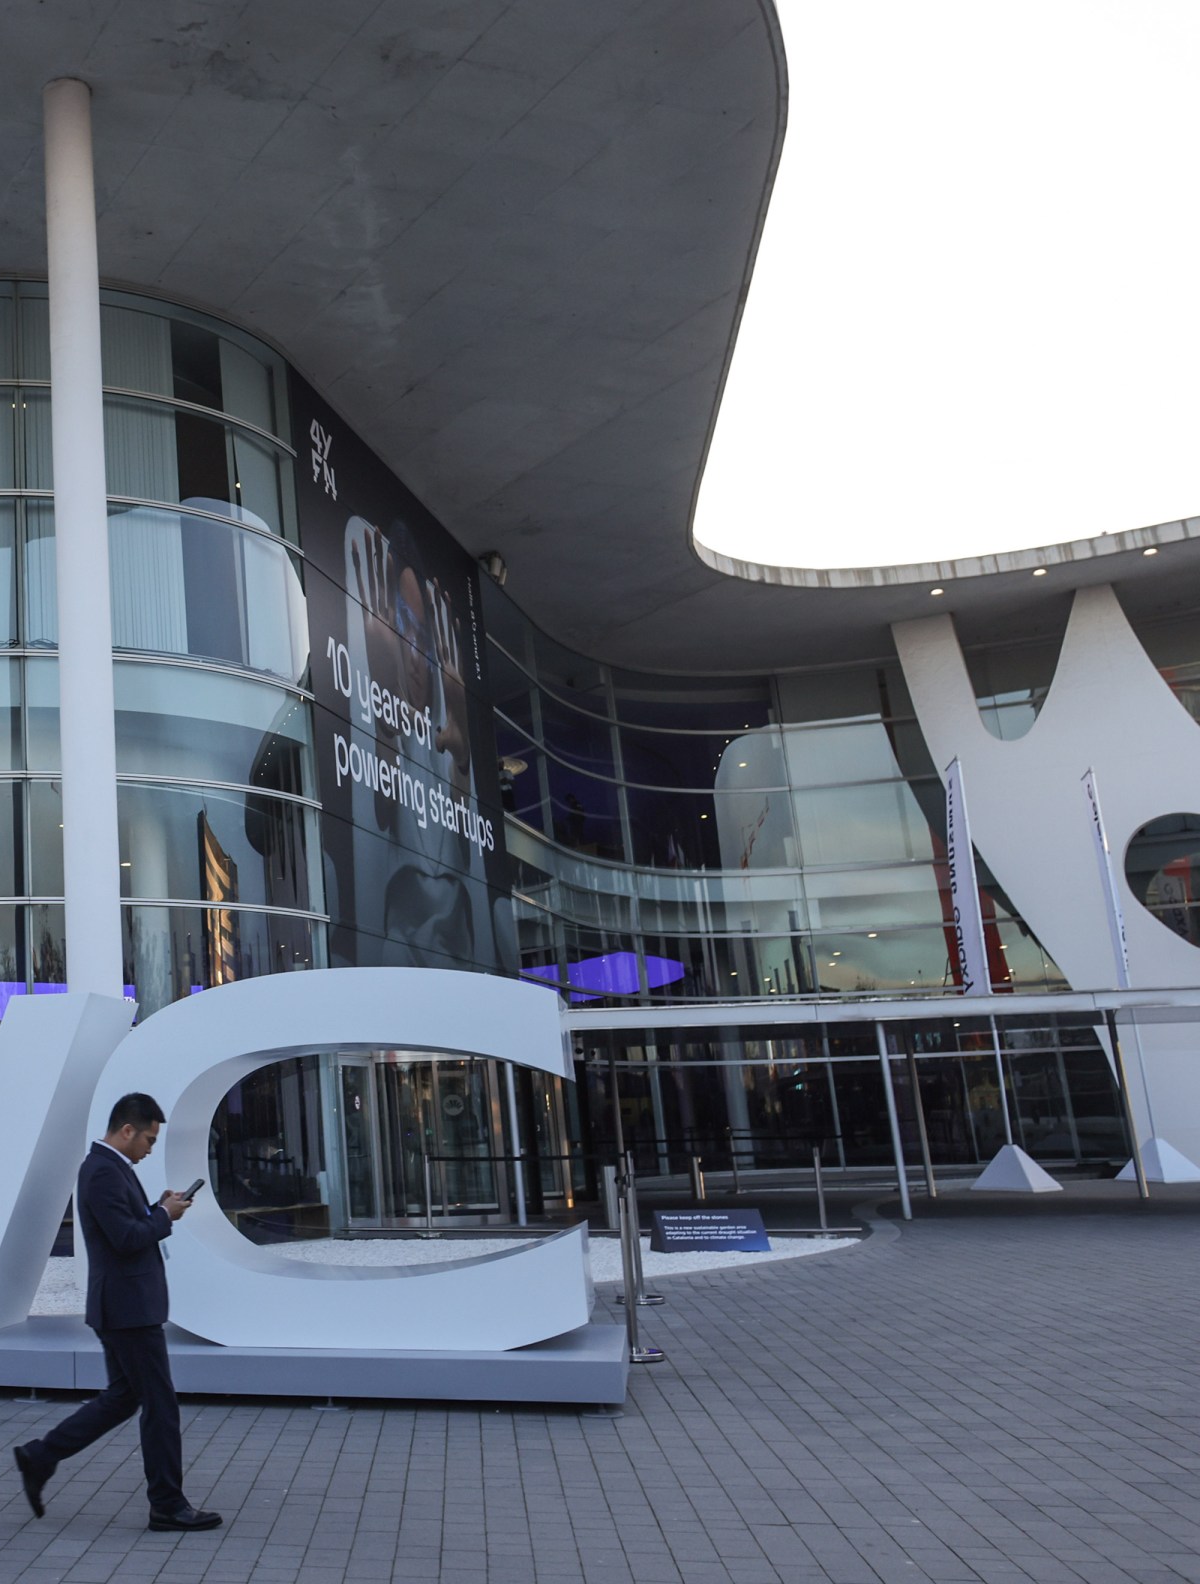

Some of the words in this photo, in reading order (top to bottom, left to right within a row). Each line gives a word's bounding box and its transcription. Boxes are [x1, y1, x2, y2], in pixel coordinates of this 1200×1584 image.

[326, 635, 353, 698] 10
[356, 670, 412, 738] years
[413, 705, 433, 751] of
[333, 732, 428, 830] powering
[428, 782, 495, 857] startups
